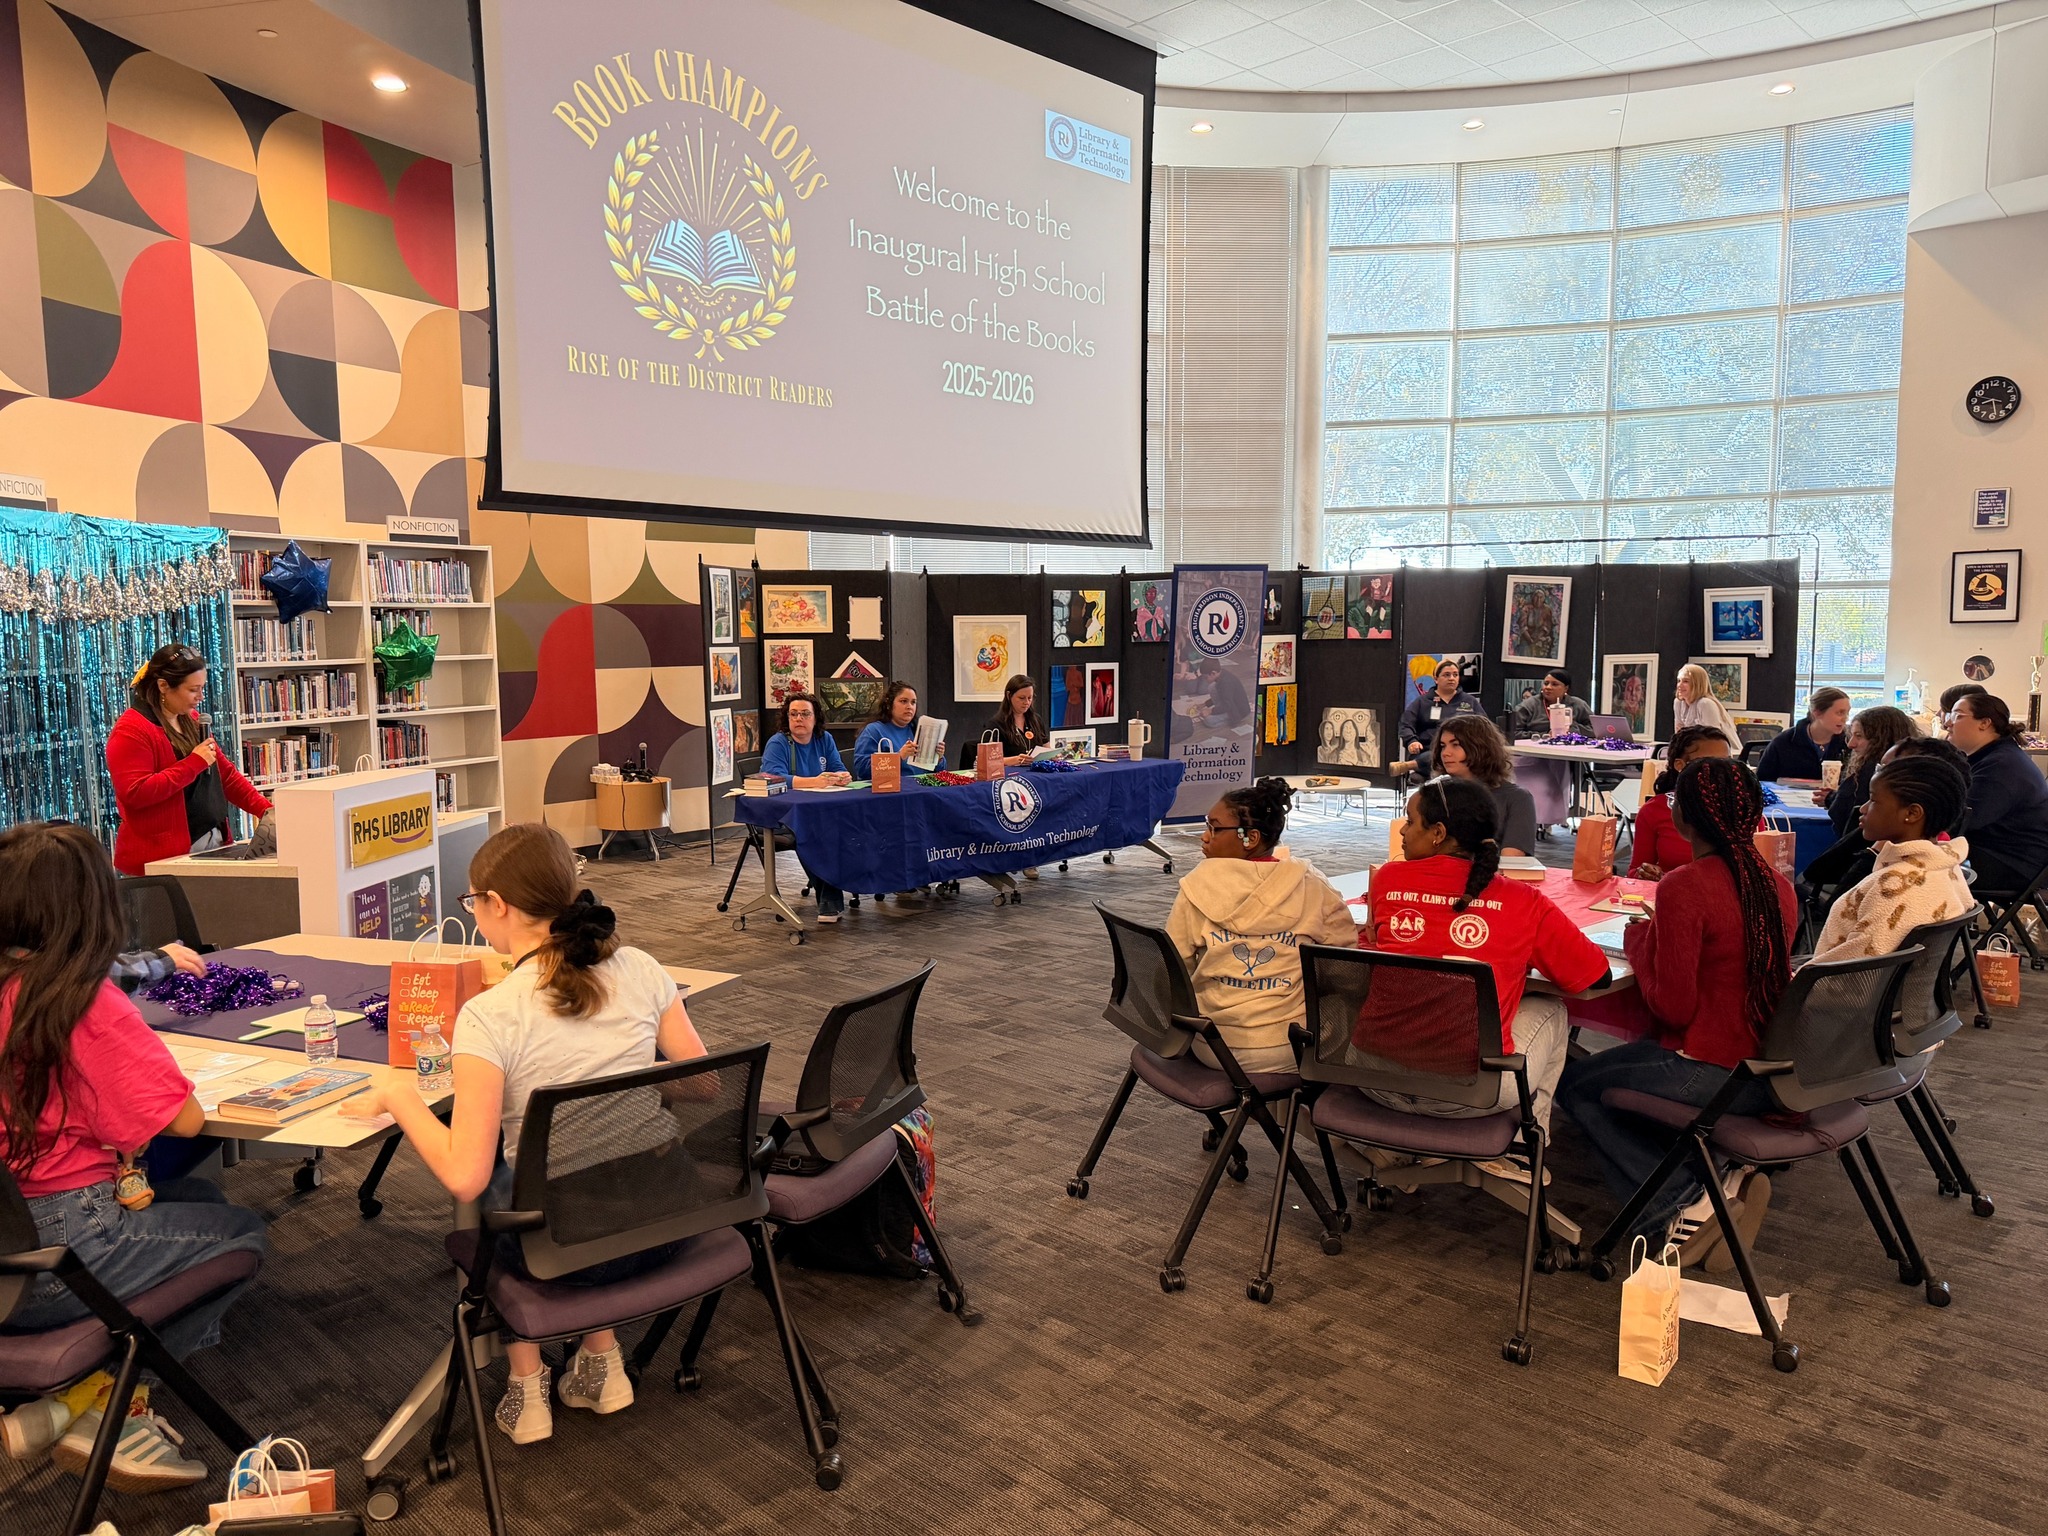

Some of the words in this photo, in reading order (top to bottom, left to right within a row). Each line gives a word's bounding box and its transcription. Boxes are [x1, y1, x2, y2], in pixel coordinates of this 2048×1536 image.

[552, 52, 653, 150] BOOK
[654, 49, 828, 200] CHAMPIONS
[1079, 127, 1111, 149] Library
[1112, 138, 1119, 150] &
[1079, 140, 1128, 165] Information
[1079, 152, 1125, 178] Technology
[894, 166, 1000, 221] Welcome
[1006, 200, 1030, 228] to
[1036, 199, 1071, 240] the
[850, 218, 966, 276] Inaugural
[974, 249, 1026, 296] High
[1032, 260, 1105, 305] School
[866, 286, 944, 328] Battle
[950, 298, 978, 334] of
[983, 302, 1020, 343] the
[1026, 320, 1095, 358] Books
[618, 357, 639, 380] OF
[647, 361, 680, 386] THE
[942, 360, 1034, 405] 2025-2026
[392, 520, 454, 532] NONFICTION
[1193, 593, 1218, 630] RICHARDSON
[1219, 592, 1244, 629] INDEPENDENT
[1207, 613, 1227, 635] R
[1195, 634, 1215, 653] SCHOOL
[1216, 633, 1240, 653] DISTRICT
[1183, 745, 1227, 757] Library
[1231, 743, 1239, 753] &
[1006, 792, 1026, 812] R
[354, 817, 380, 844] RHS
[382, 806, 430, 838] LIBRARY
[999, 814, 1017, 830] SCHOOL
[1018, 808, 1038, 830] DISTRICT
[927, 846, 965, 862] Library
[967, 843, 976, 855] &
[980, 837, 1045, 854] Information
[1046, 824, 1100, 845] Technology
[1386, 891, 1402, 900] CATS
[1403, 892, 1419, 903] OUT,
[1422, 894, 1447, 905] CLAWS
[1486, 900, 1503, 911] OUT
[359, 916, 381, 935] HELP
[413, 973, 431, 986] Eat
[410, 986, 439, 1002] Sleep
[409, 1001, 437, 1013] Read
[407, 1012, 446, 1027] Repeat
